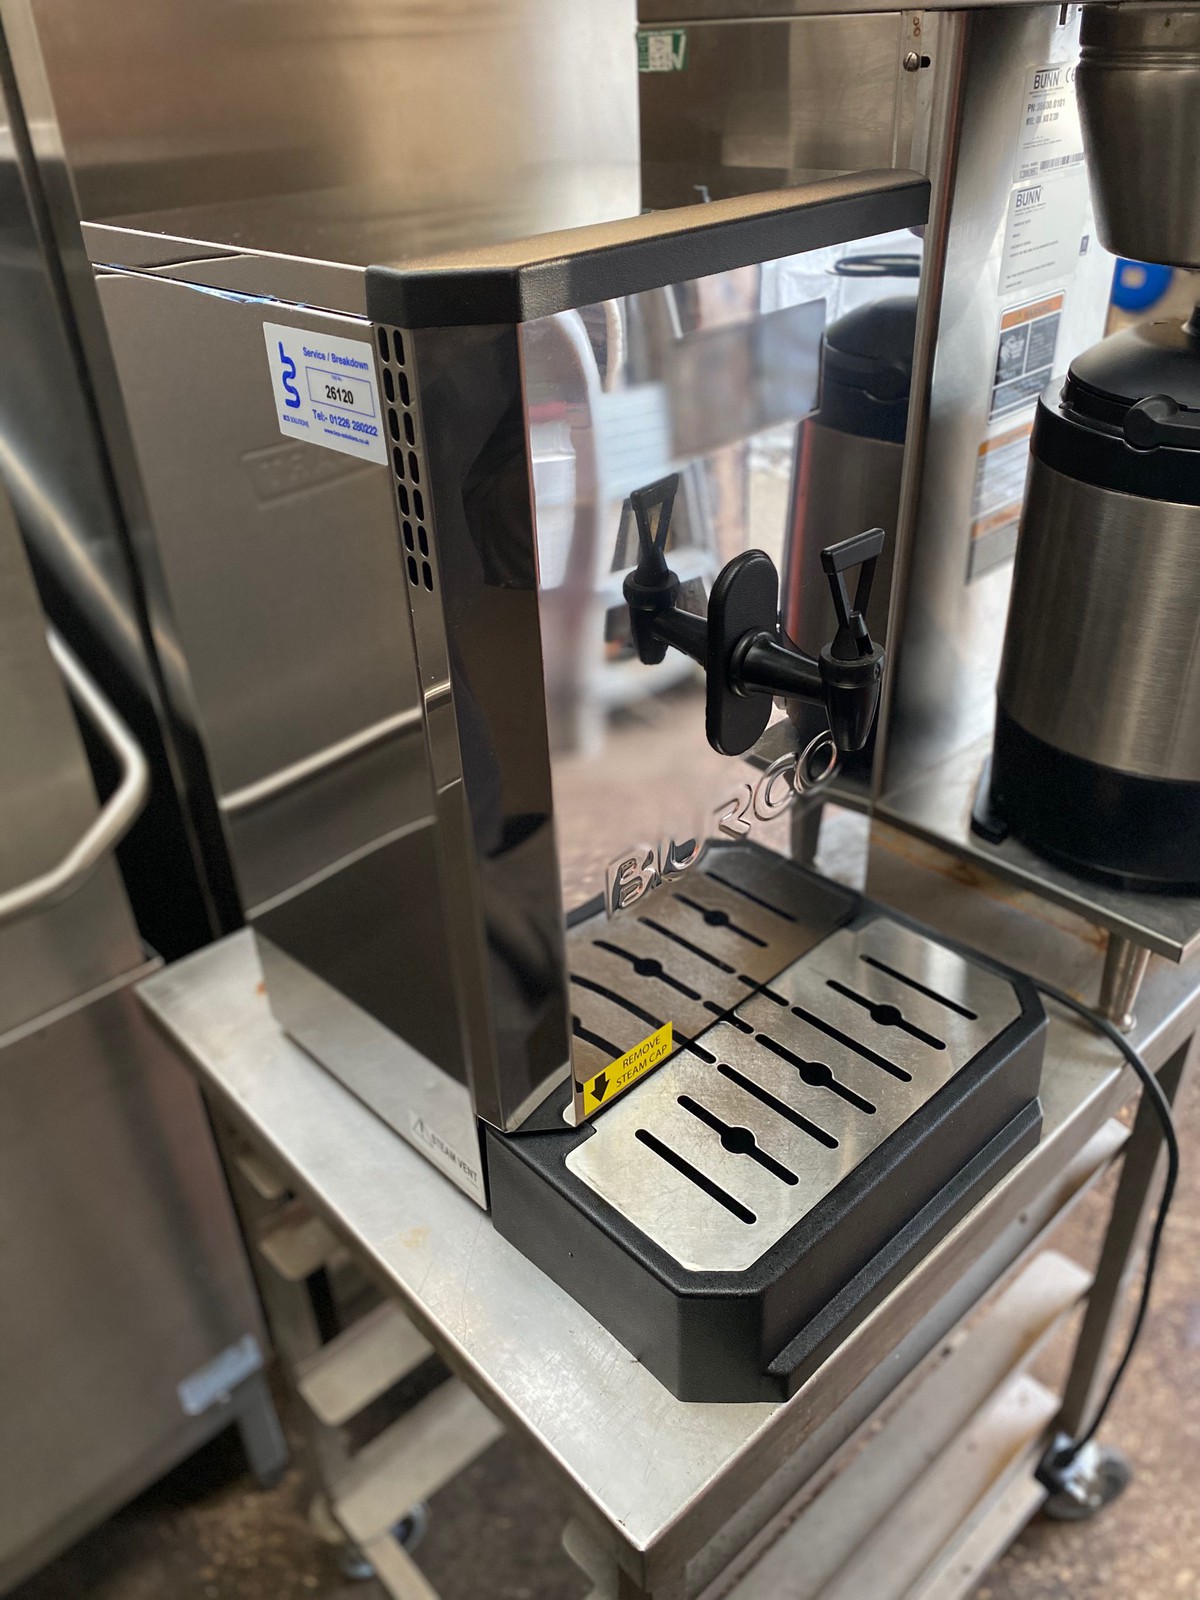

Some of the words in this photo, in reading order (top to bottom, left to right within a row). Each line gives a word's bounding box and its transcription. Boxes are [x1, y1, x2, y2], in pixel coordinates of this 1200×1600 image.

[1033, 71, 1060, 89] BUNN
[1015, 188, 1042, 208] BUNN
[303, 347, 325, 362] Service
[331, 353, 369, 371] Breakdown
[325, 384, 354, 405] 26120
[329, 414, 351, 429] 01226
[352, 420, 378, 437] 280222
[622, 1035, 661, 1069] REMOVE
[616, 1061, 648, 1088] STEAM
[648, 1044, 668, 1063] CAP
[431, 1133, 457, 1163] STEAM
[457, 1157, 477, 1182] VENT
